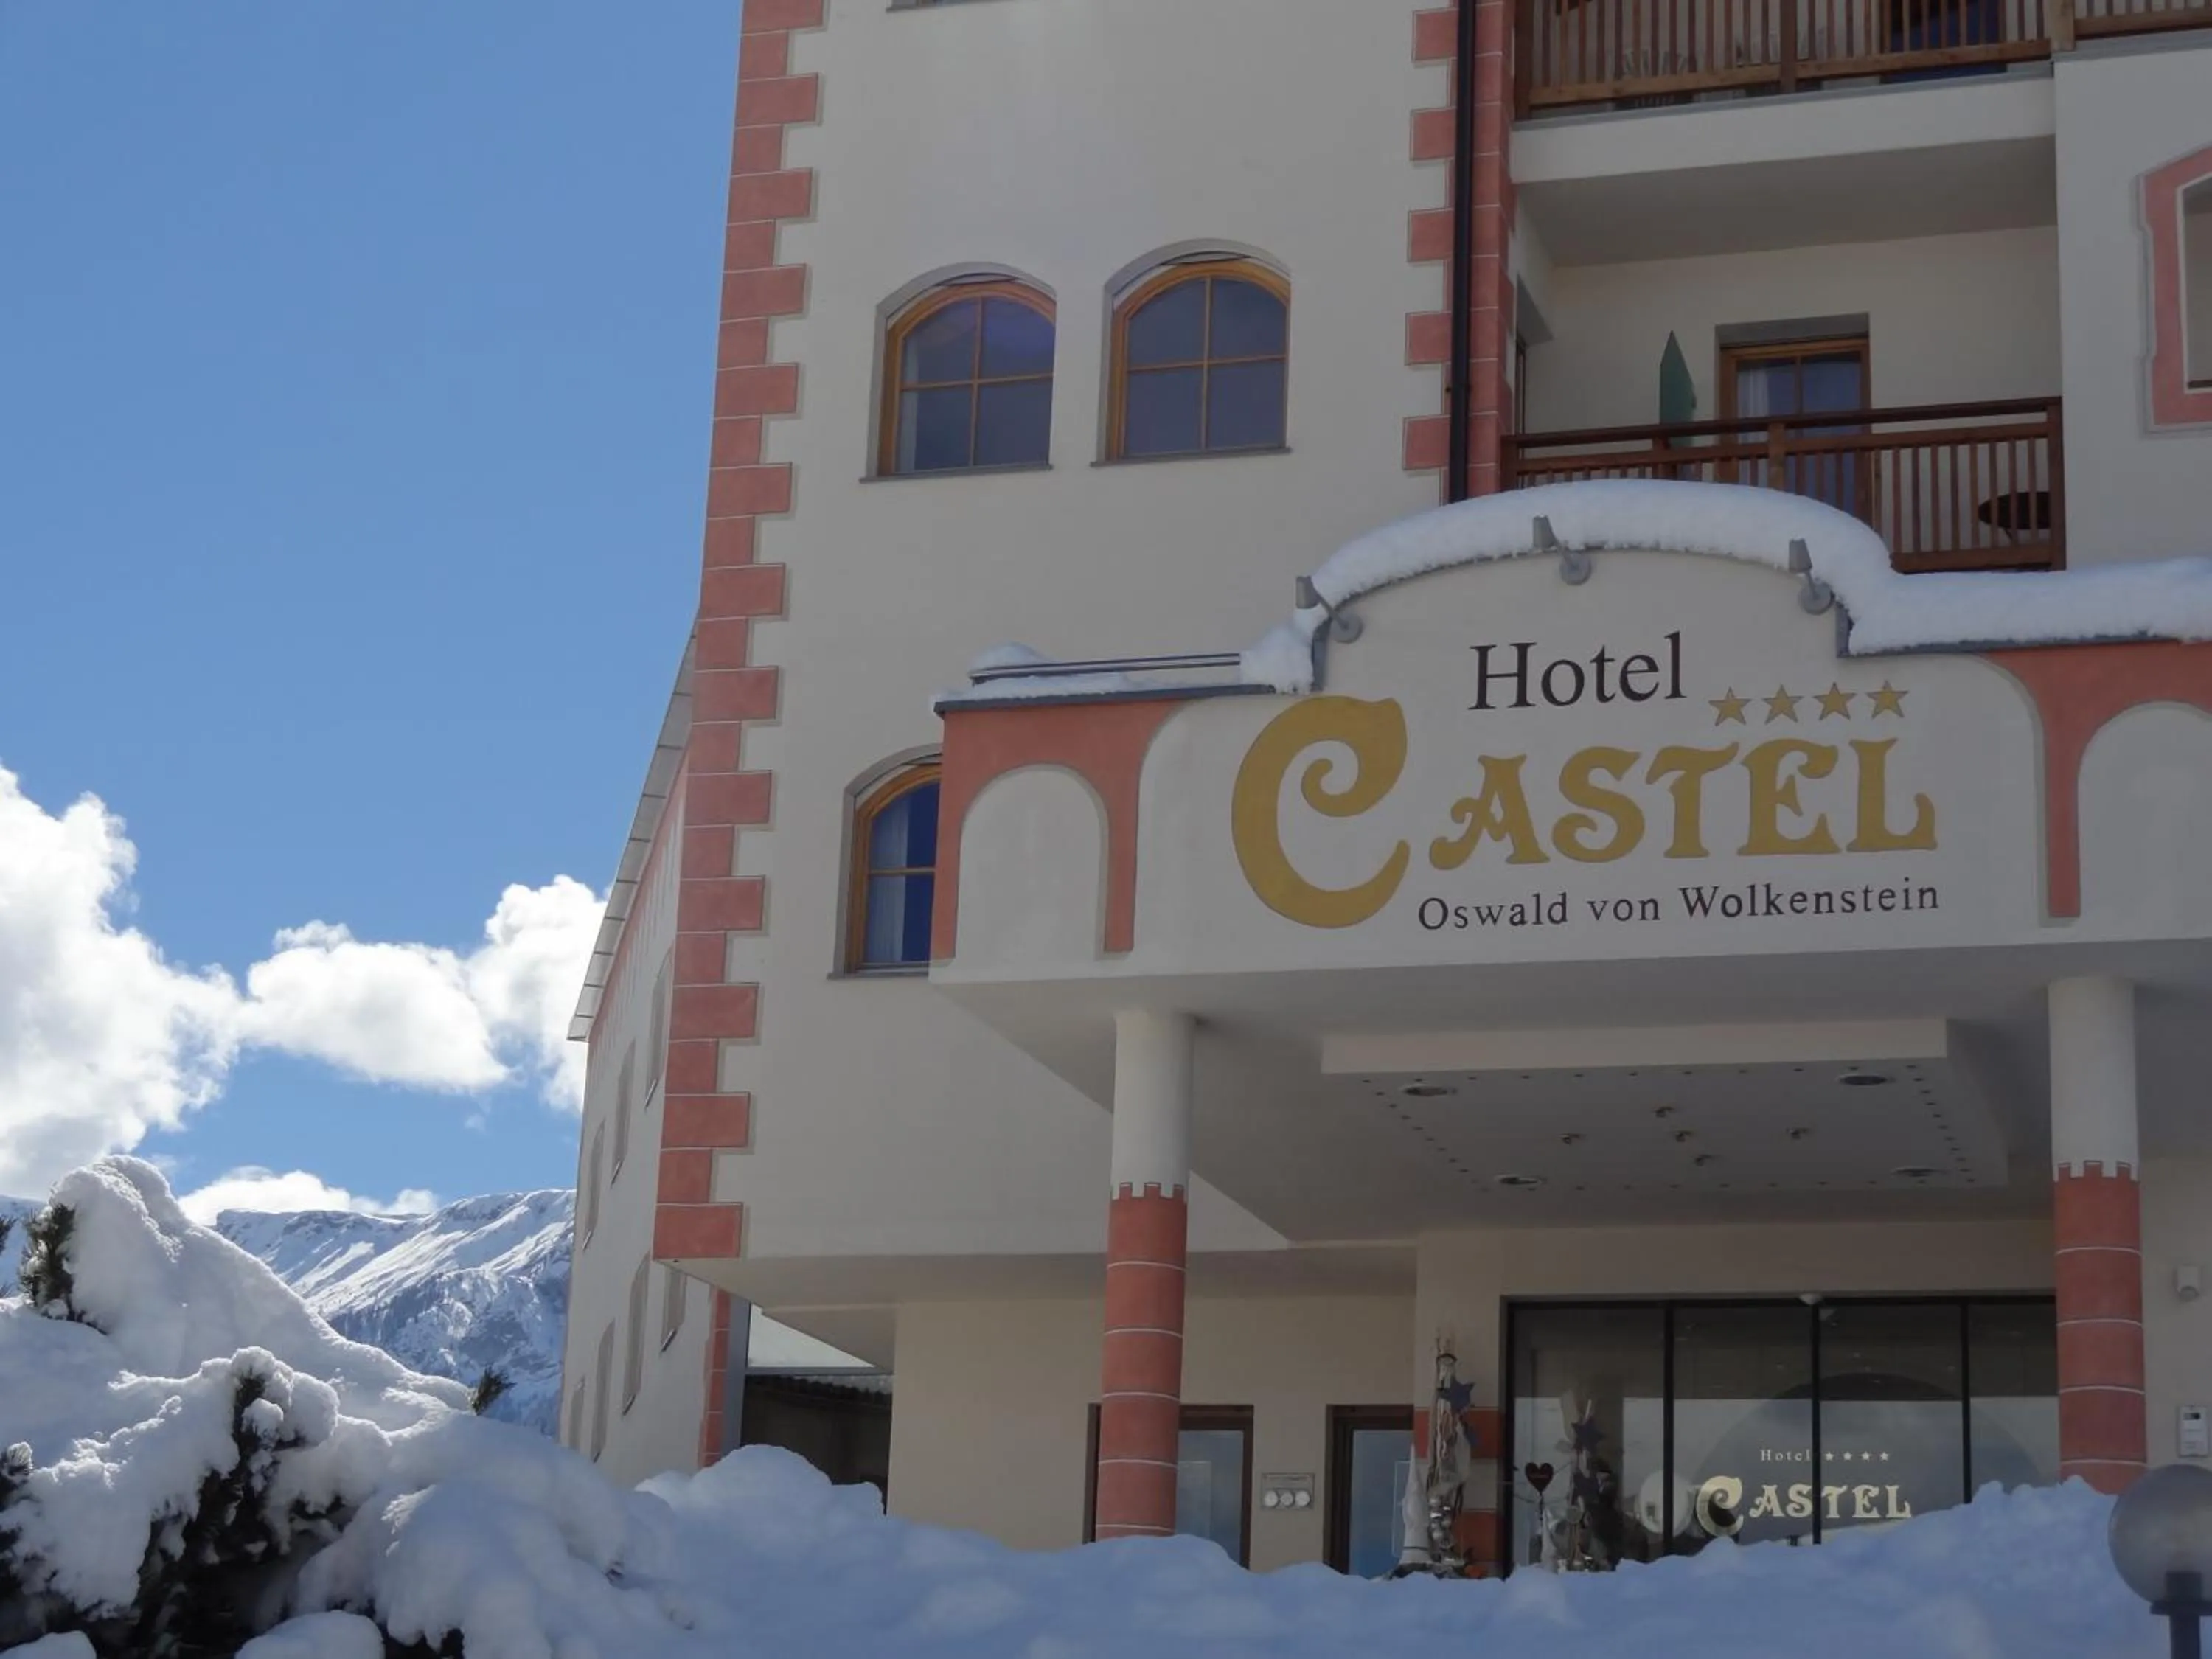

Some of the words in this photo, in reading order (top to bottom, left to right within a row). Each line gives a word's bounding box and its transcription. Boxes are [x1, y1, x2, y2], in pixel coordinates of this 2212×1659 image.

[1468, 631, 1687, 710] Hotel
[1231, 695, 1938, 929] CASTEL
[1418, 891, 1568, 930] Oswald
[1587, 896, 1661, 923] von
[1678, 878, 1939, 921] Wolkenstein
[1760, 1449, 1812, 1462] Hotel
[1697, 1475, 1912, 1536] CASTEL
